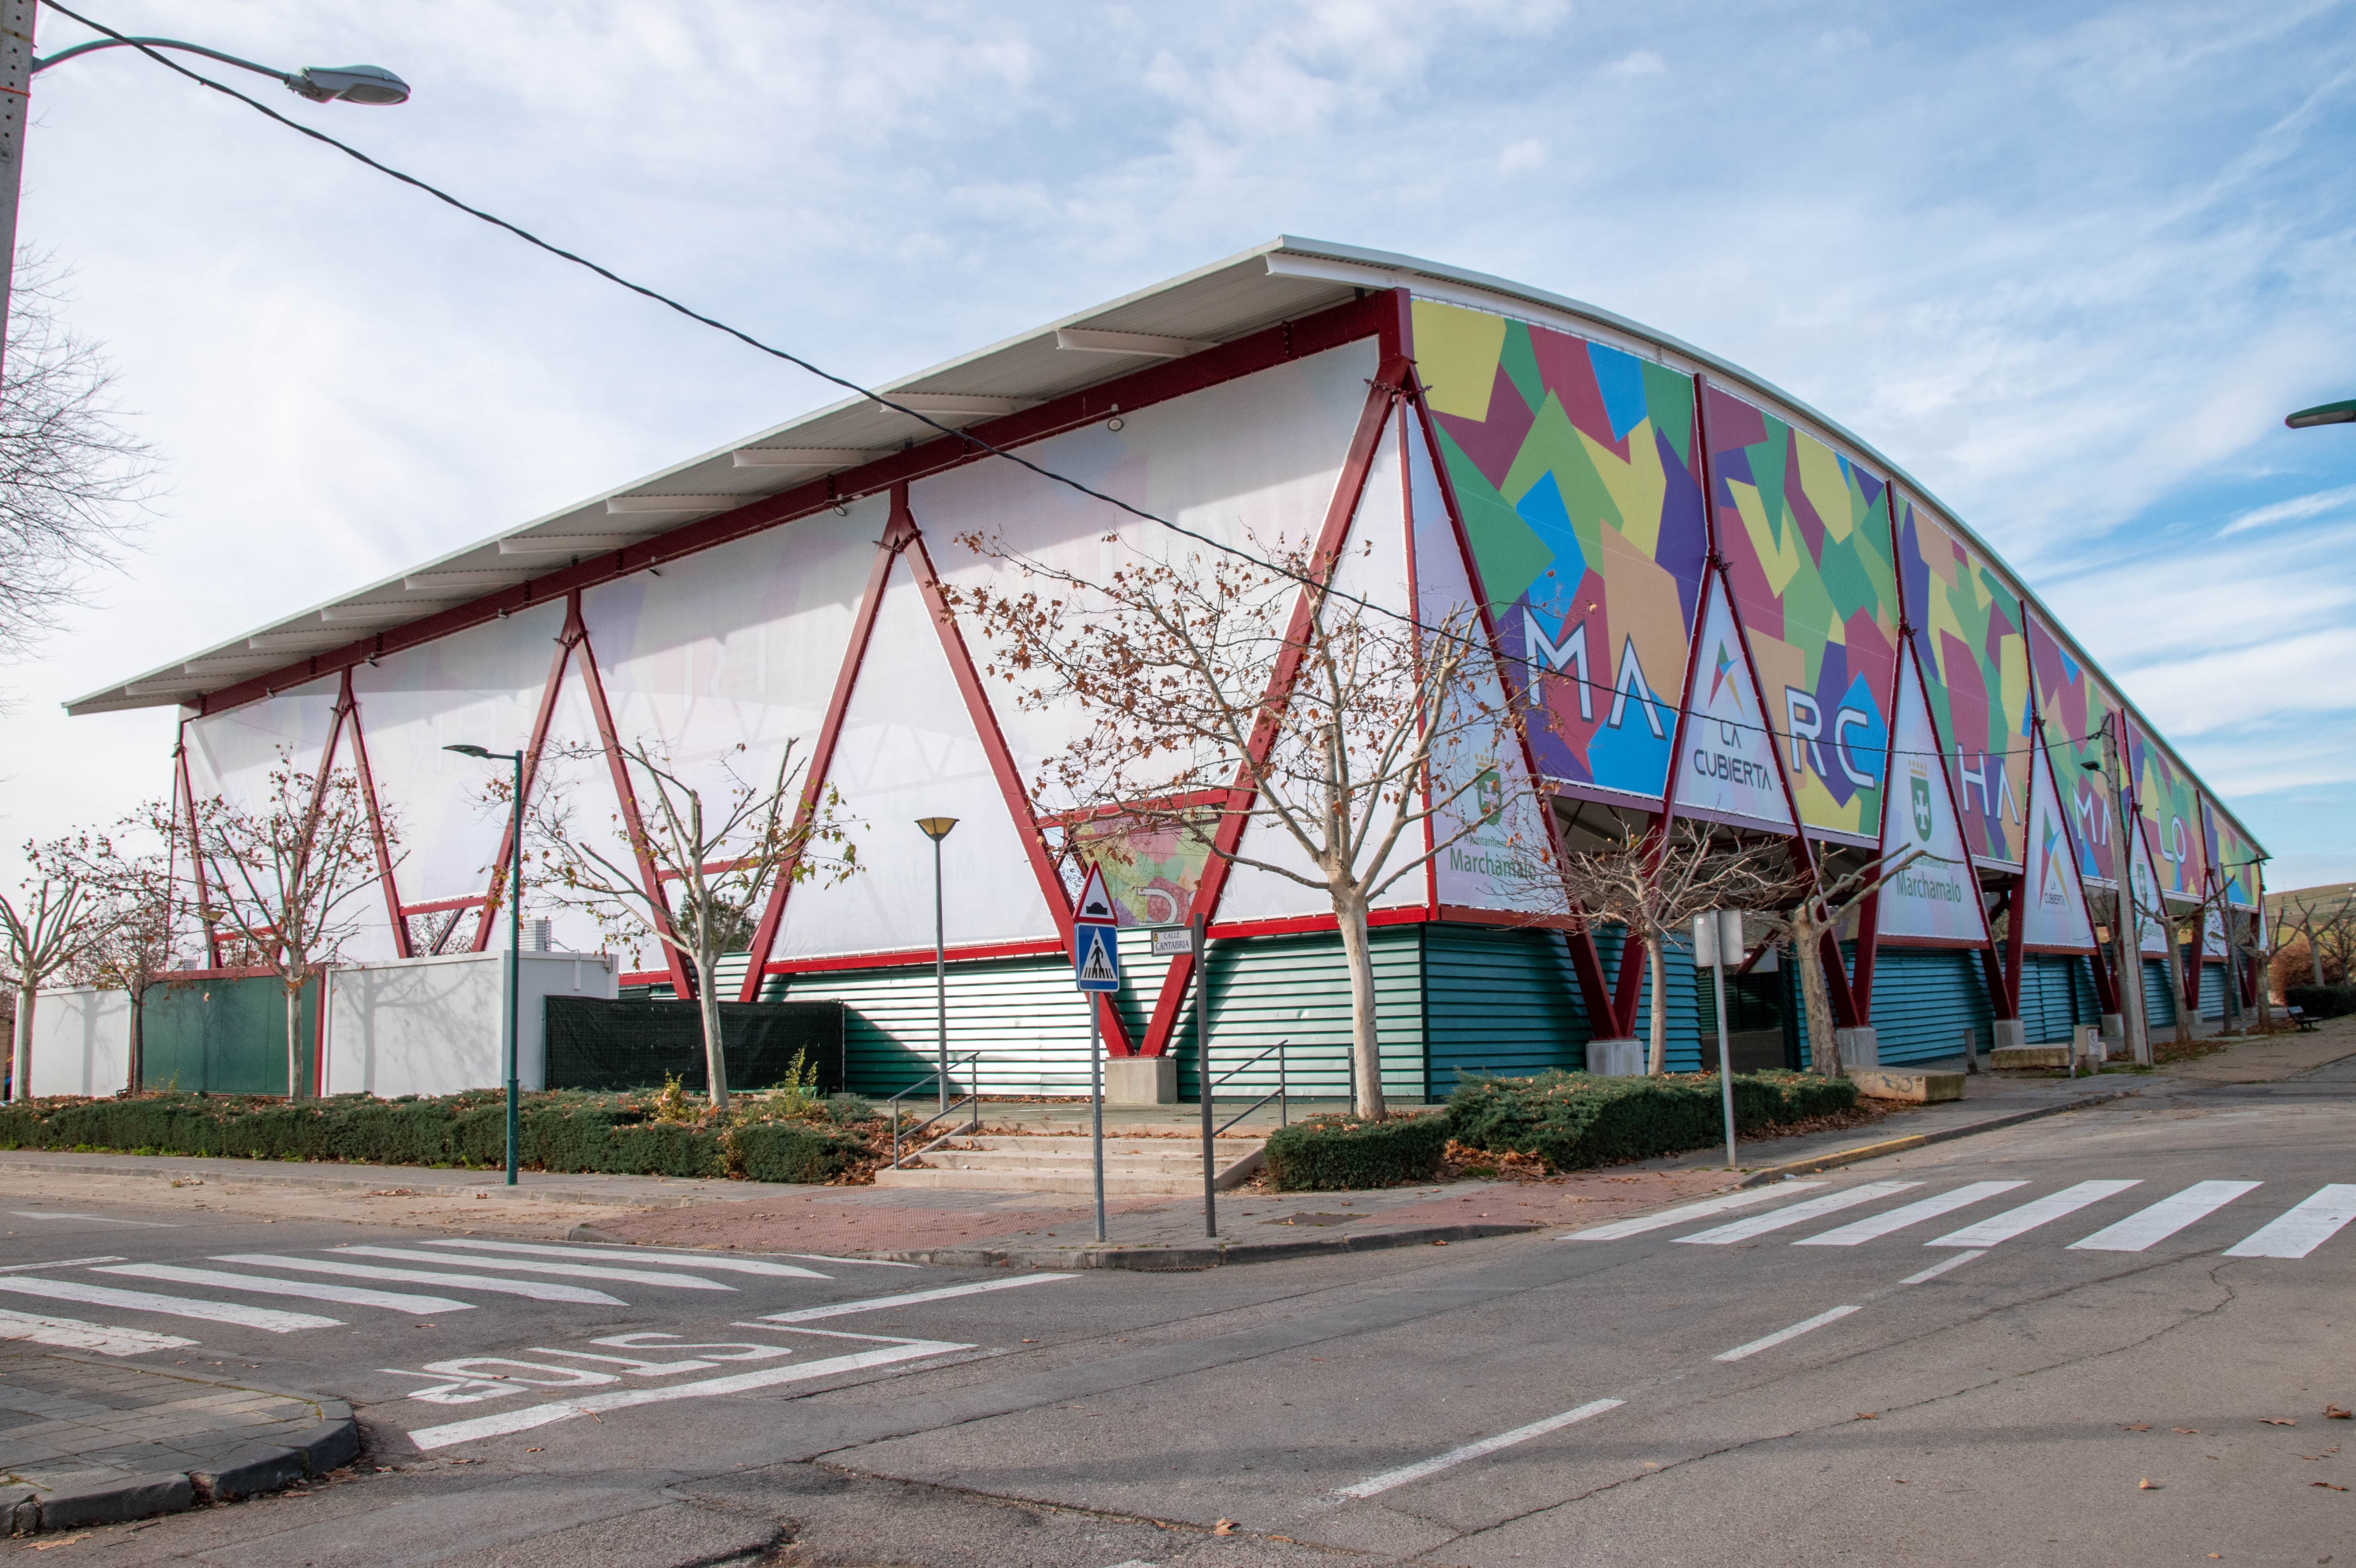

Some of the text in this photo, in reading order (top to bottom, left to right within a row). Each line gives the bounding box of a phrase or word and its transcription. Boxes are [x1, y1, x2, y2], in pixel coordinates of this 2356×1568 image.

[1522, 604, 1667, 741] MA
[1785, 685, 1875, 791] RC
[1957, 742, 2021, 825] HA
[2156, 808, 2186, 864] LO
[1720, 721, 1741, 749] LA
[1694, 749, 1772, 791] CUBIERTA
[1896, 870, 1961, 903] Marchamalo
[2044, 893, 2066, 905] CUBIERTA
[2050, 879, 2056, 890] LA
[1155, 940, 1189, 951] CANTABRIA
[375, 1332, 793, 1404] STOP
